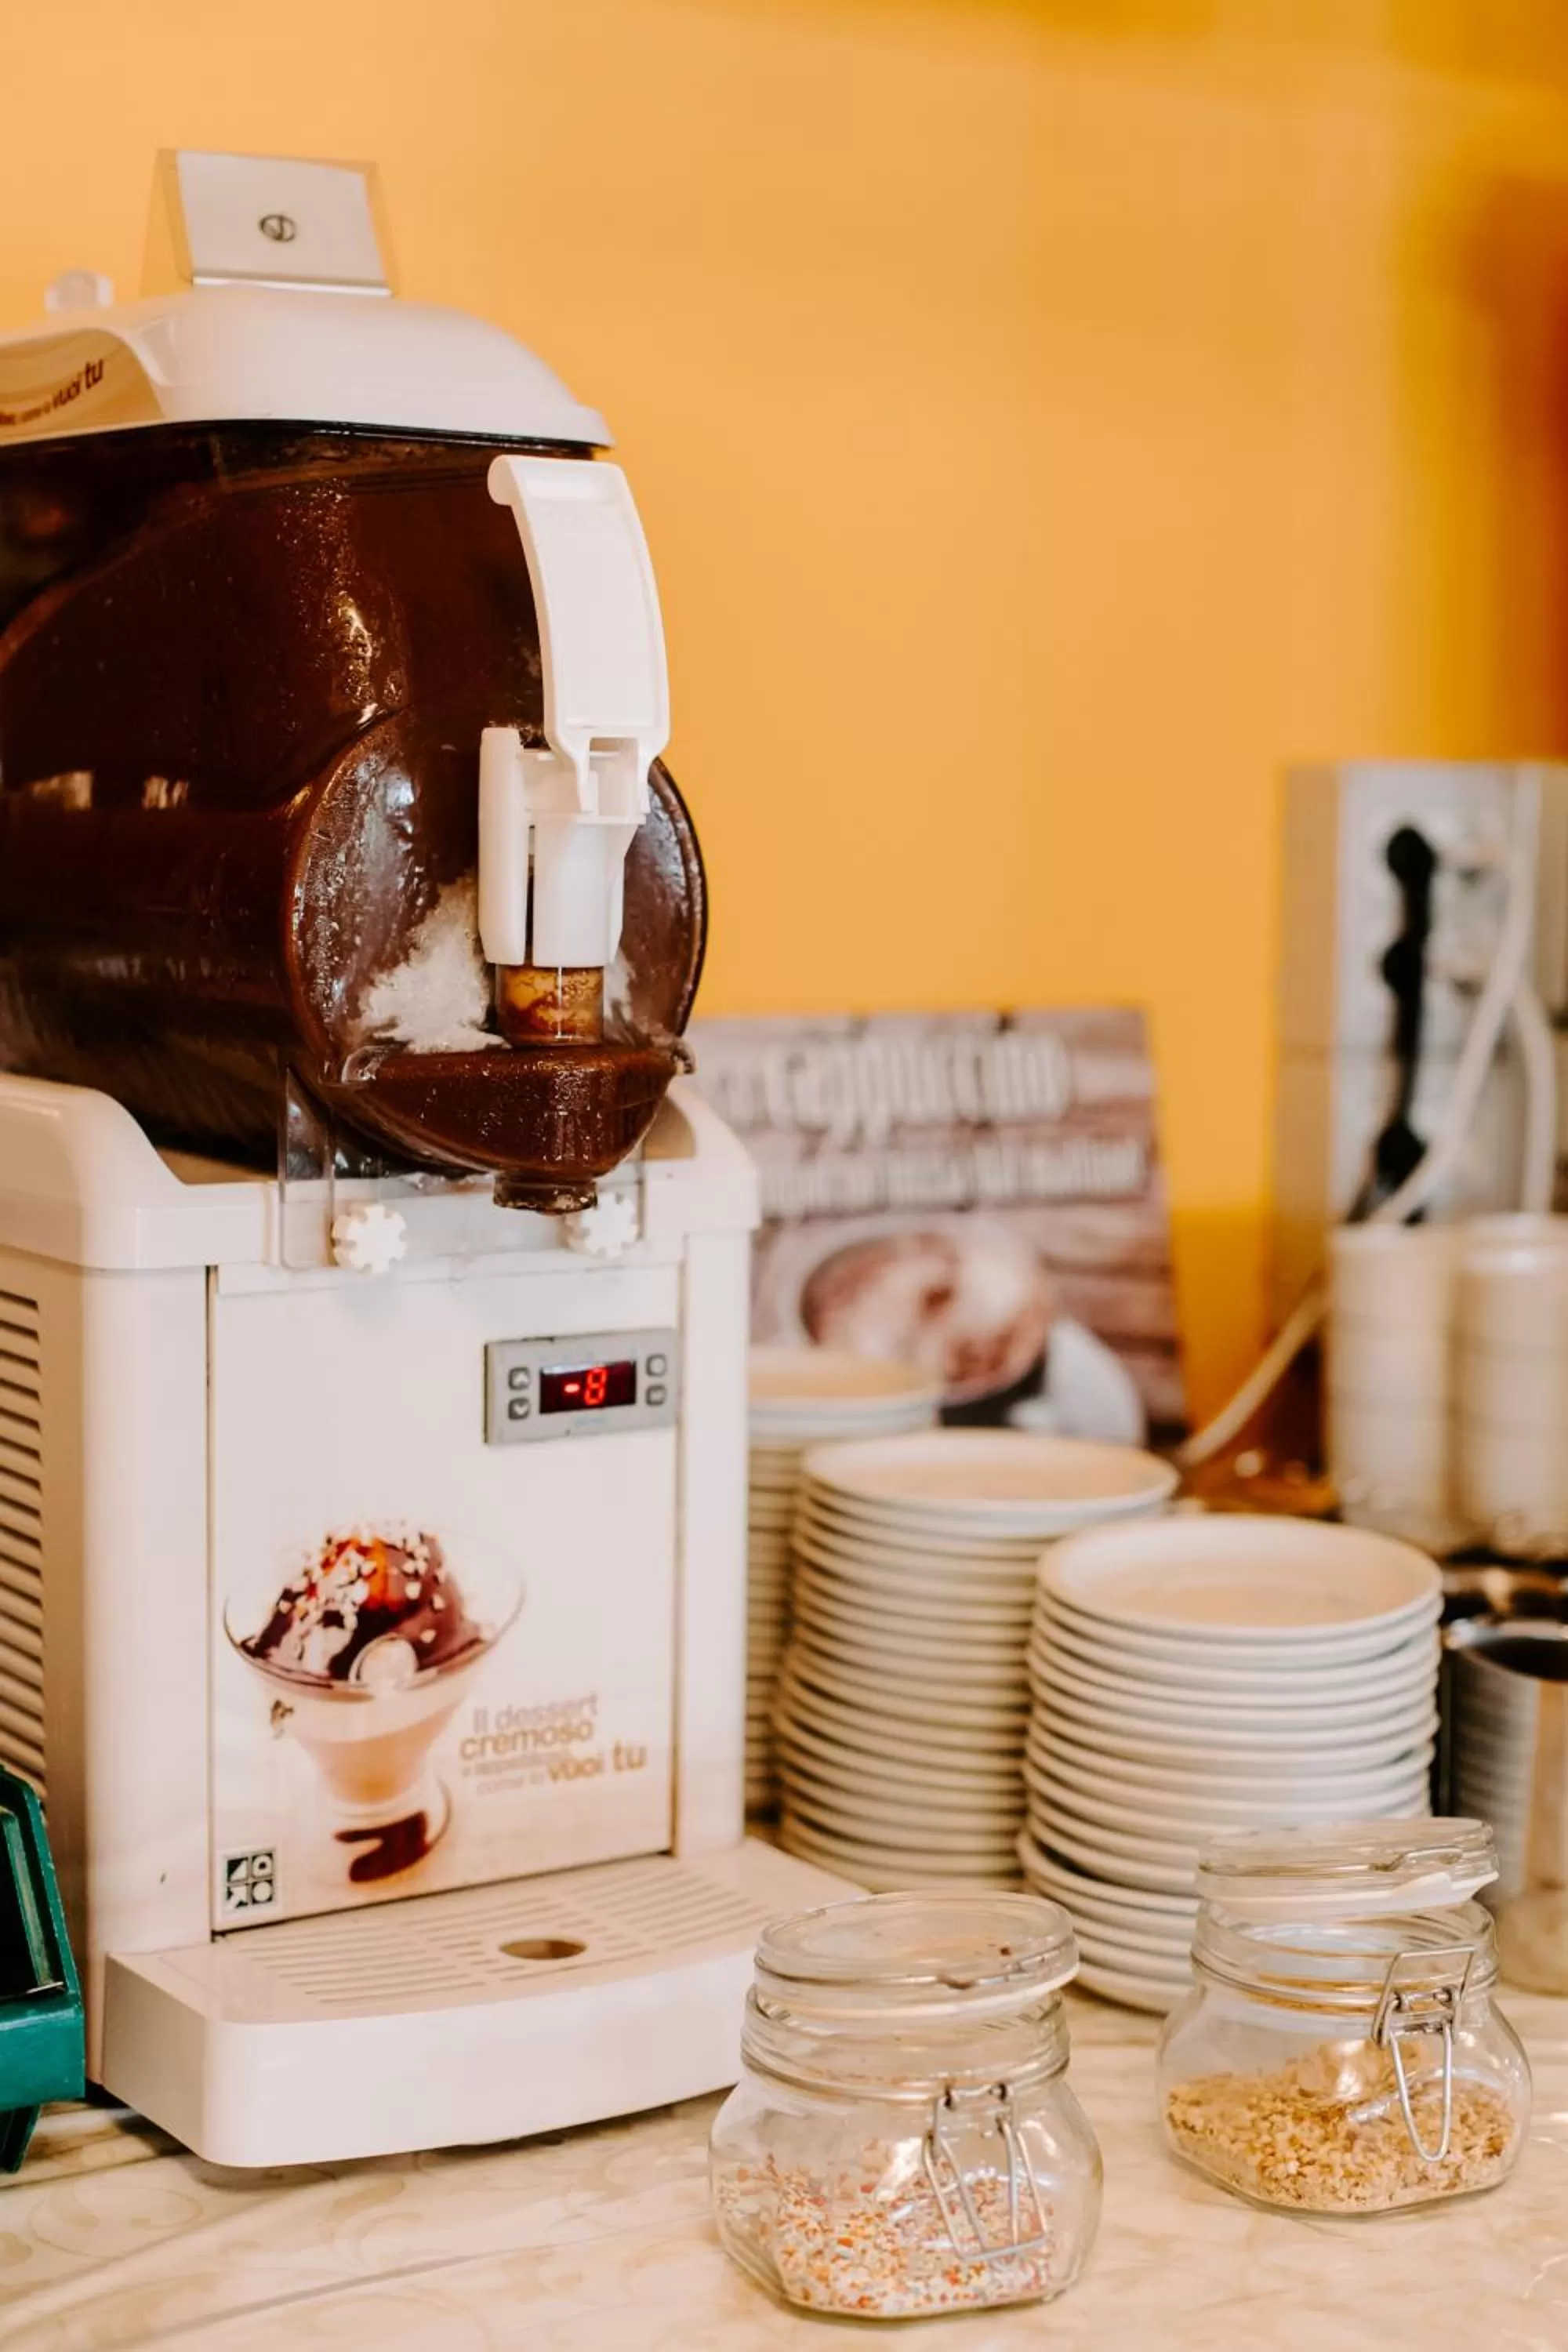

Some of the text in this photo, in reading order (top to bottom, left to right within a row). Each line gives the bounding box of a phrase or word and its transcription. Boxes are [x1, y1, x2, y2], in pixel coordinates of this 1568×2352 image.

[85, 358, 103, 390] tu
[564, 1367, 608, 1405] -8
[495, 1690, 599, 1731] dessert
[460, 1718, 594, 1760] cremoso
[548, 1750, 604, 1782] vuoi
[612, 1738, 647, 1772] tu
